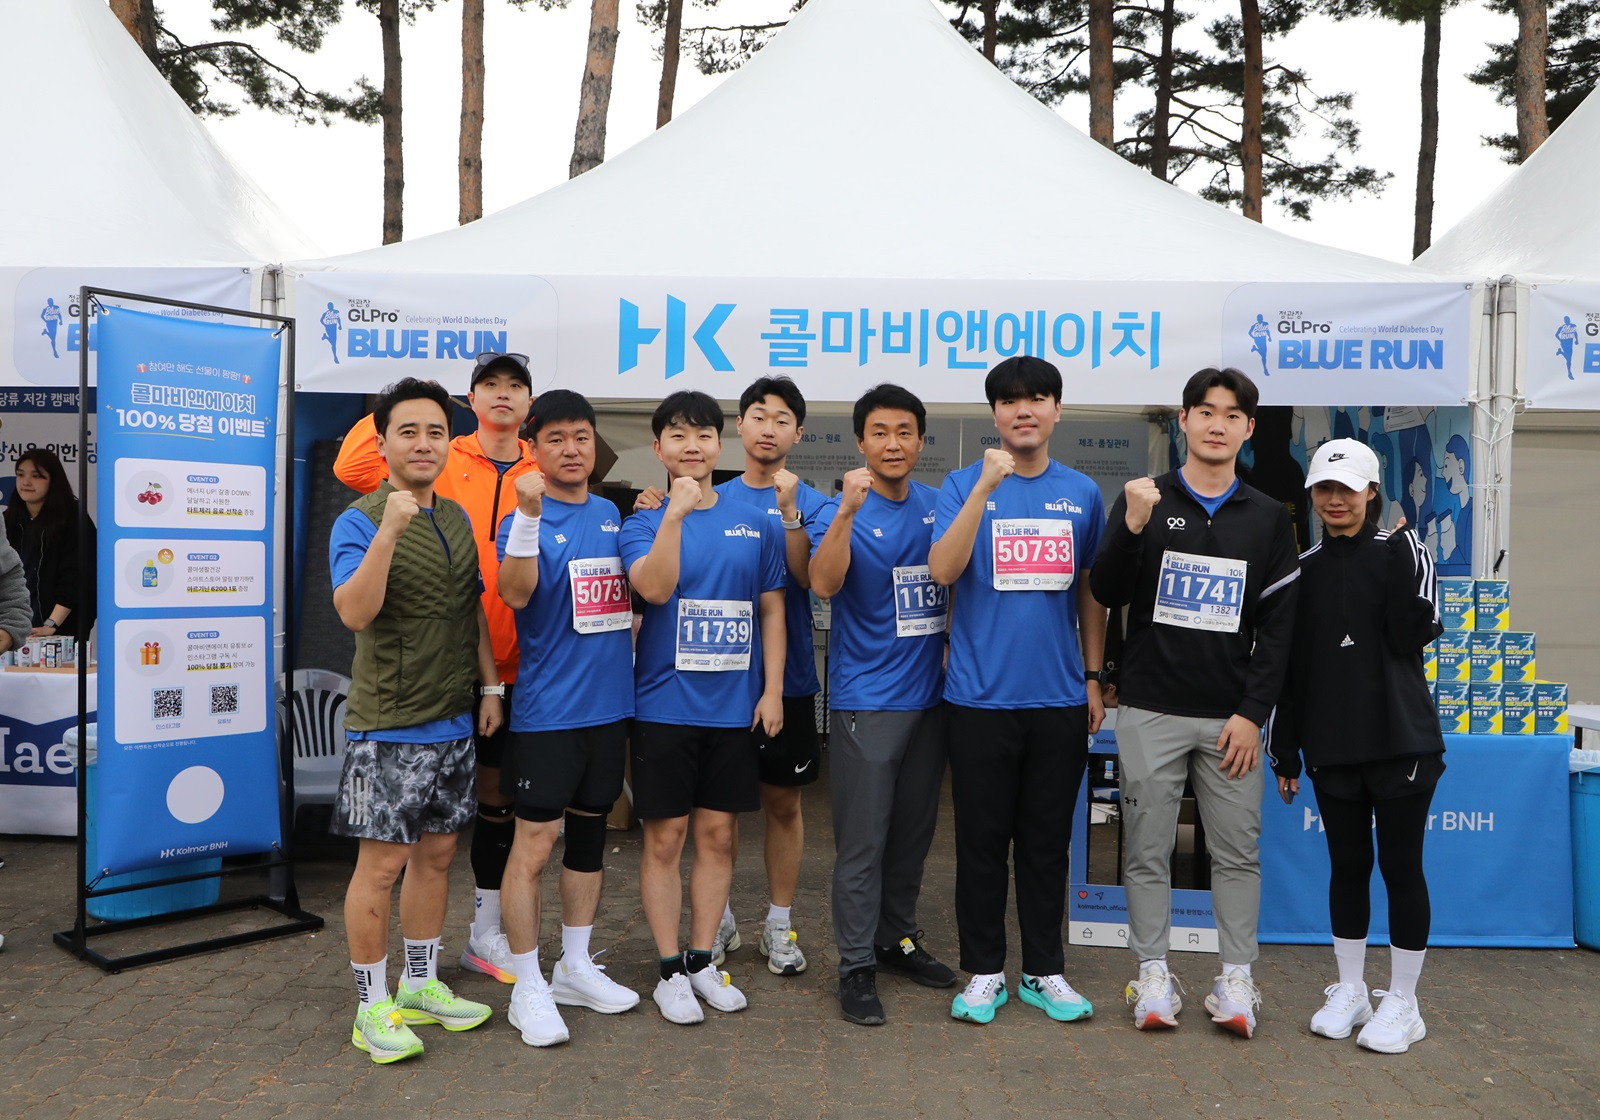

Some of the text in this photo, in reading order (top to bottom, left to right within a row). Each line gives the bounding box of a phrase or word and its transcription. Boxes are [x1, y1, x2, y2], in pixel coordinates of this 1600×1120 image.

[347, 299, 371, 308] 정관장
[405, 315, 508, 326] Celebrating World Diabetes Day
[1278, 310, 1303, 320] 정관장
[618, 293, 737, 380] HK
[1339, 325, 1444, 335] Celebrating World Diabetes Day
[347, 328, 507, 360] BLUE RUN
[760, 308, 1160, 370] 콜마비앤에이치
[1278, 339, 1444, 370] BLUE RUN
[149, 361, 241, 381] 참여만 해도 선물이 팡팡!
[23, 393, 47, 407] 저감
[131, 382, 256, 414] 콜마비앤에이치
[116, 409, 265, 438] 100% 당첨 이벤트
[825, 433, 841, 444] 원료
[1078, 438, 1130, 449] 제조·품질관리
[187, 487, 205, 495] 에너지
[1045, 502, 1082, 514] BLUE RUN
[724, 529, 760, 538] BLUE RUN
[1023, 528, 1040, 536] RUN
[1061, 529, 1071, 537] 5k
[997, 539, 1071, 563] 50733
[580, 568, 598, 576] BLUE
[599, 567, 611, 575] RUN
[1170, 561, 1244, 578] BLUE RUN 10k
[901, 573, 932, 582] BLUE RU
[576, 579, 628, 604] 50731
[1164, 573, 1239, 604] 11741
[688, 608, 707, 616] BLUE
[738, 609, 751, 617] 10k
[1210, 605, 1231, 615] 1382
[683, 620, 750, 643] 11739
[187, 653, 217, 661] 인스타그램
[1442, 811, 1494, 832] BNH
[176, 845, 209, 855] Kolmar
[209, 841, 228, 850] BNH
[1077, 903, 1128, 912] kolmarbnh_officia
[406, 944, 428, 978] RUNDAY
[353, 968, 369, 1004] RUNDAY
